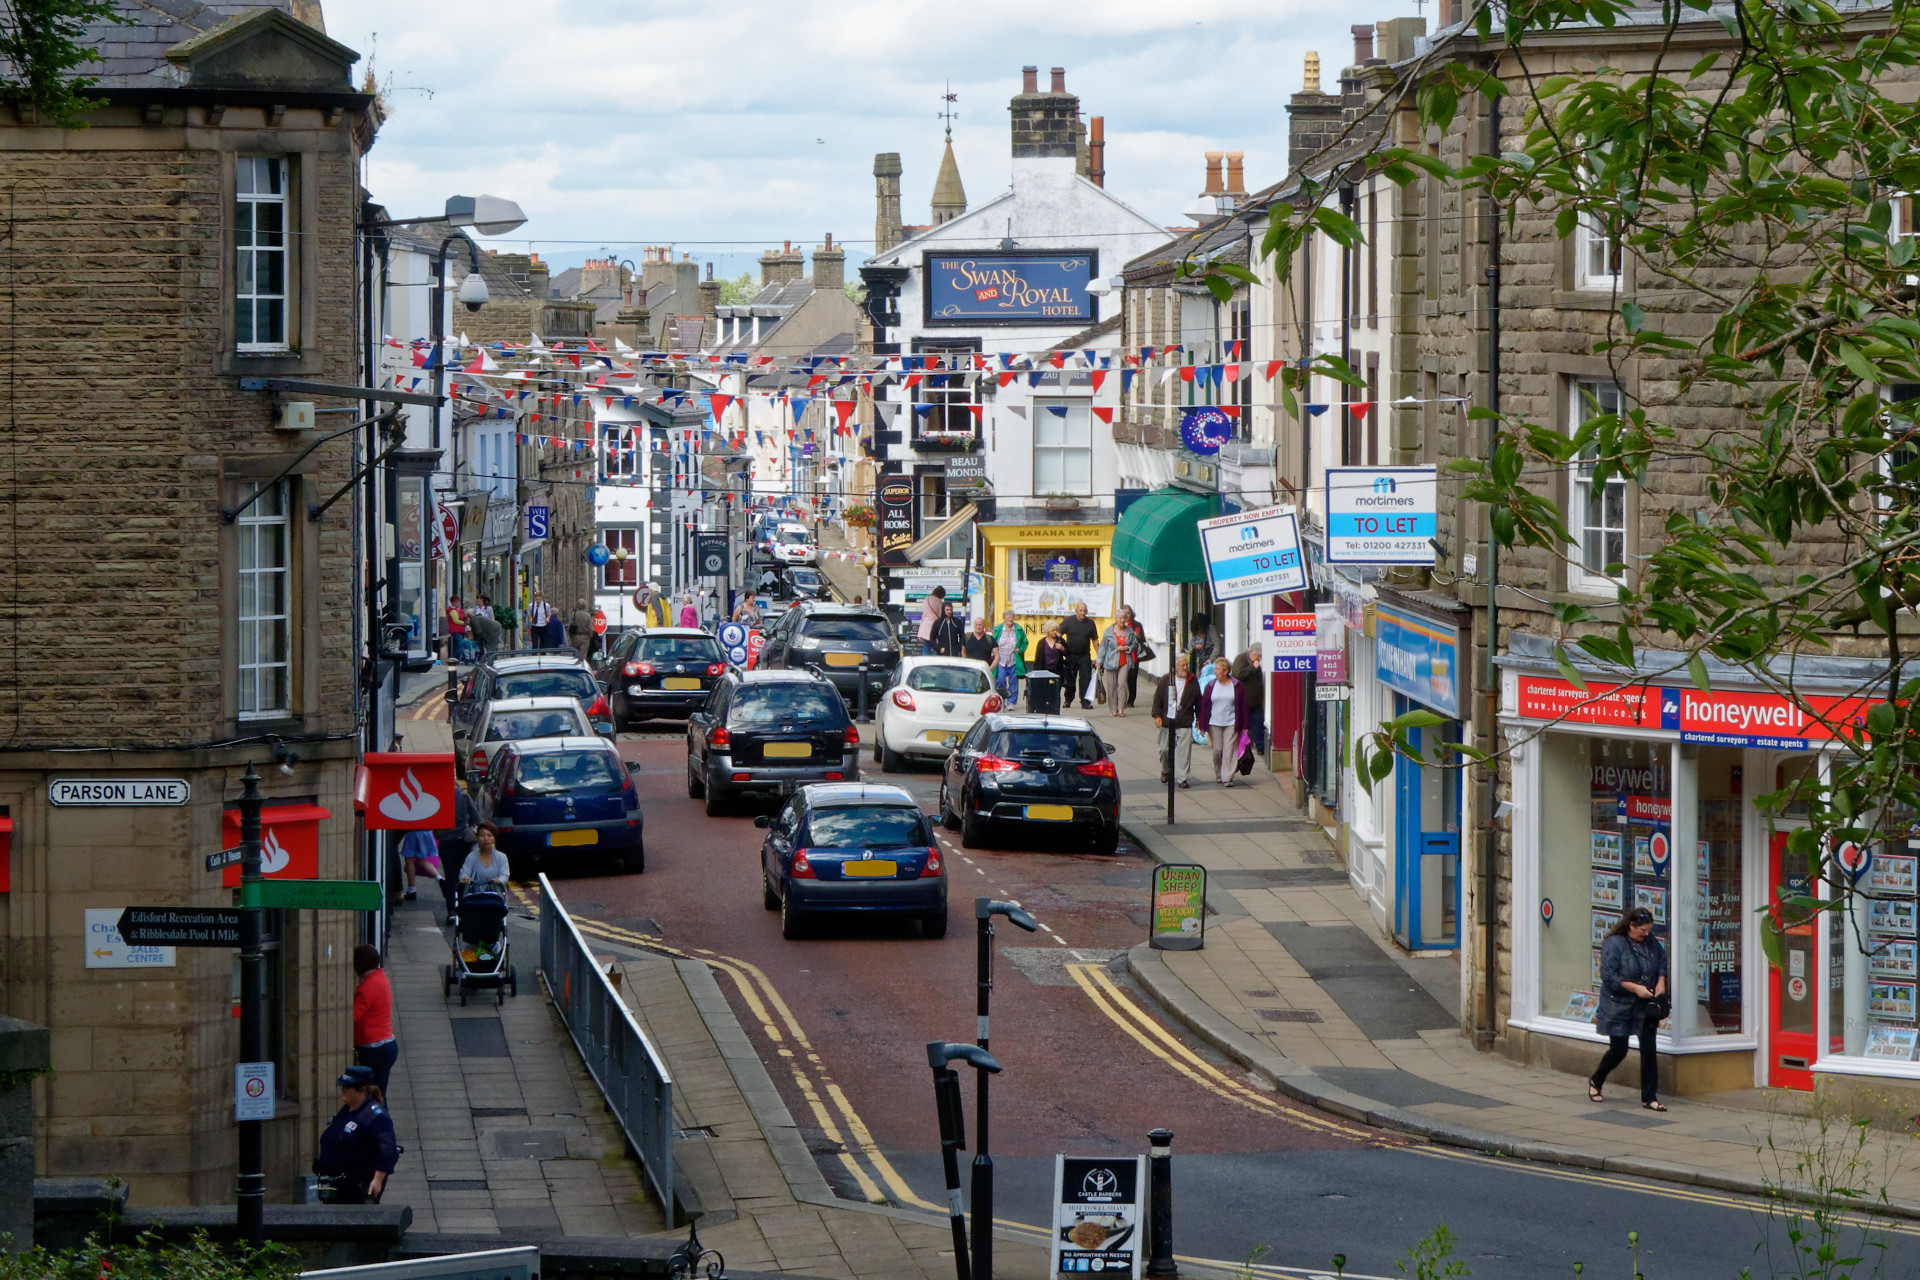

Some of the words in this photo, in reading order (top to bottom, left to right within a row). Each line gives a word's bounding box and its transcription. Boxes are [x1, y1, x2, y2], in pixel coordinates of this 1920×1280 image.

[940, 261, 959, 270] THE
[952, 260, 1016, 291] SWAN
[978, 289, 998, 301] AND
[998, 277, 1073, 308] ROYAL
[1042, 306, 1081, 316] HOTEL
[951, 457, 978, 466] BEAU
[946, 468, 984, 477] MONDE
[1355, 495, 1415, 506] mortimers
[887, 509, 905, 518] ALL
[1208, 515, 1242, 526] PROPERTY
[1244, 512, 1260, 520] NOW
[1261, 508, 1284, 517] EMPTY
[884, 520, 910, 529] ROOMS
[1354, 517, 1379, 533] TO
[1385, 517, 1418, 533] LET
[891, 533, 911, 545] Suite
[1345, 541, 1360, 549] Tel:
[1363, 541, 1391, 549] 01200
[1394, 541, 1426, 549] 427331
[1228, 538, 1275, 553] mortimers
[1253, 557, 1270, 570] TO
[1273, 552, 1295, 566] LET
[1227, 581, 1239, 589] Tel:
[1241, 577, 1263, 586] 01200
[1265, 573, 1290, 582] 427331
[1276, 616, 1316, 629] honeyw
[1276, 640, 1304, 648] 01200
[1318, 652, 1342, 661] Frank
[1277, 658, 1290, 669] to
[1294, 657, 1311, 669] let
[1527, 684, 1557, 697] chartered
[1557, 689, 1589, 701] surveyors
[1527, 700, 1646, 719] www.honywell.co.k
[1685, 694, 1803, 729] honeywell
[1684, 732, 1716, 743] chartered
[1716, 735, 1748, 746] surveyors
[1756, 738, 1778, 747] estate
[1780, 739, 1803, 749] agents
[61, 785, 125, 799] PARSON
[132, 785, 178, 799] LANE
[1636, 799, 1672, 817] honeywe
[1161, 870, 1200, 881] URBAN
[1163, 881, 1198, 892] SHEEP
[131, 911, 167, 923] Edisford
[169, 912, 214, 924] Recreation
[216, 913, 239, 924] Area
[1712, 920, 1740, 930] Home
[131, 930, 139, 938] &
[139, 928, 188, 940] Ribblesdale
[189, 928, 209, 940] Pool
[217, 929, 240, 941] Mile
[130, 945, 160, 953] SALES
[1708, 940, 1736, 951] SALE
[126, 954, 164, 963] CENTRE
[1711, 961, 1736, 973] FEE
